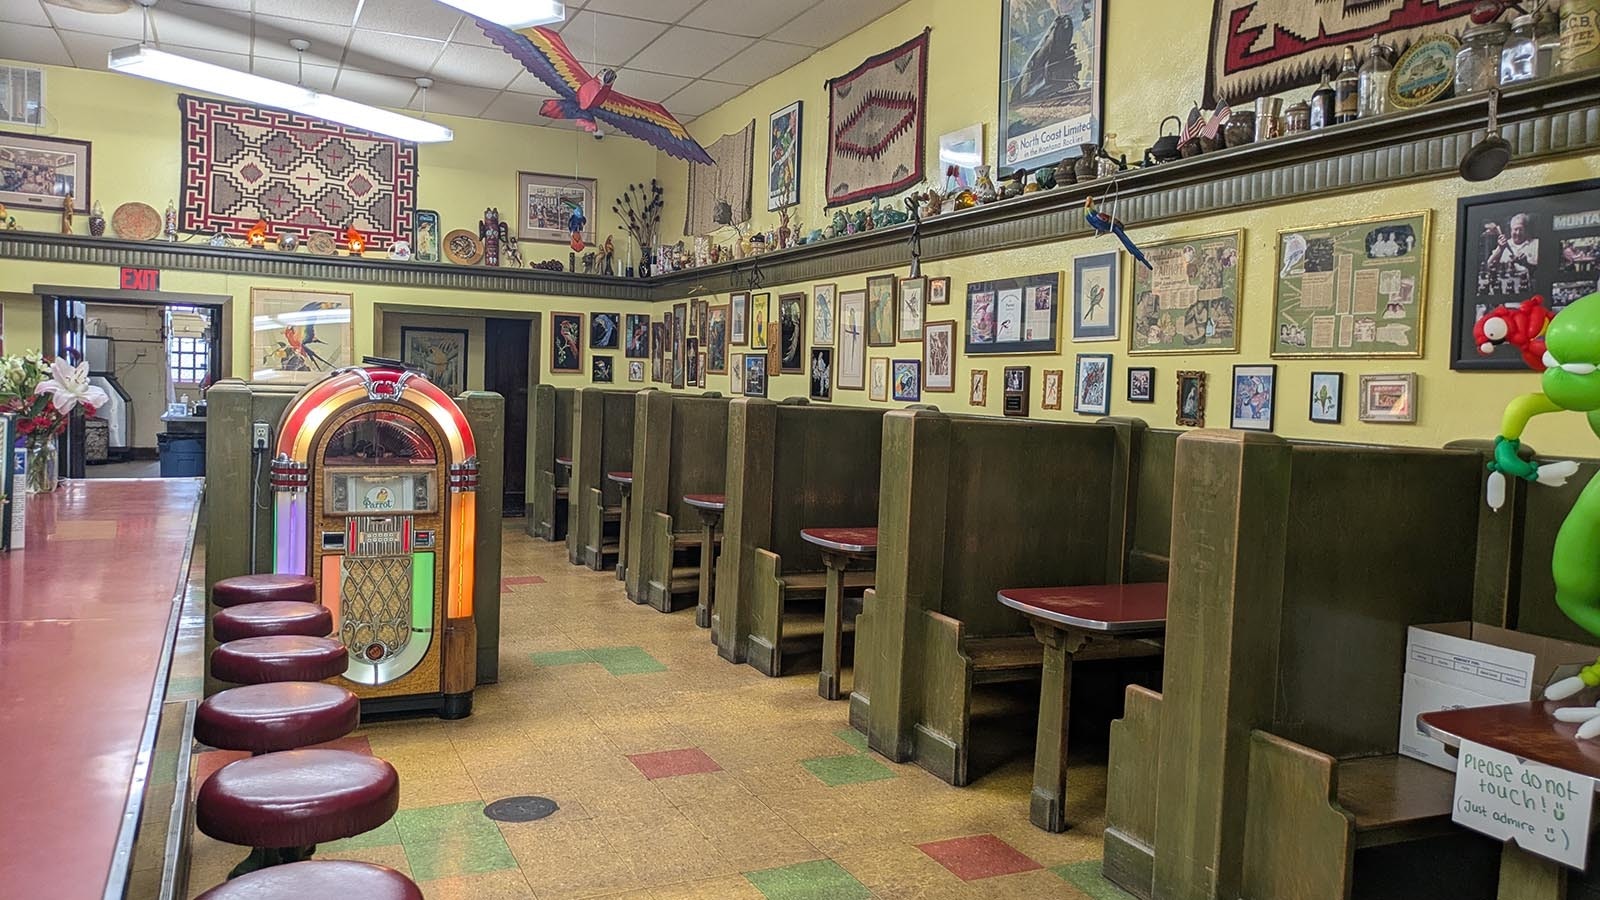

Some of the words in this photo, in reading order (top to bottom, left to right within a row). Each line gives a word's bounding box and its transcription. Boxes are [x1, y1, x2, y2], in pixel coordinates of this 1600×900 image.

[1020, 133, 1039, 150] North
[1041, 129, 1062, 143] Coast
[121, 268, 158, 291] EXIT
[363, 499, 392, 508] Parrot
[1464, 754, 1513, 782] Please
[1520, 770, 1541, 789] do
[1545, 779, 1579, 801] not
[1492, 811, 1535, 834] admire
